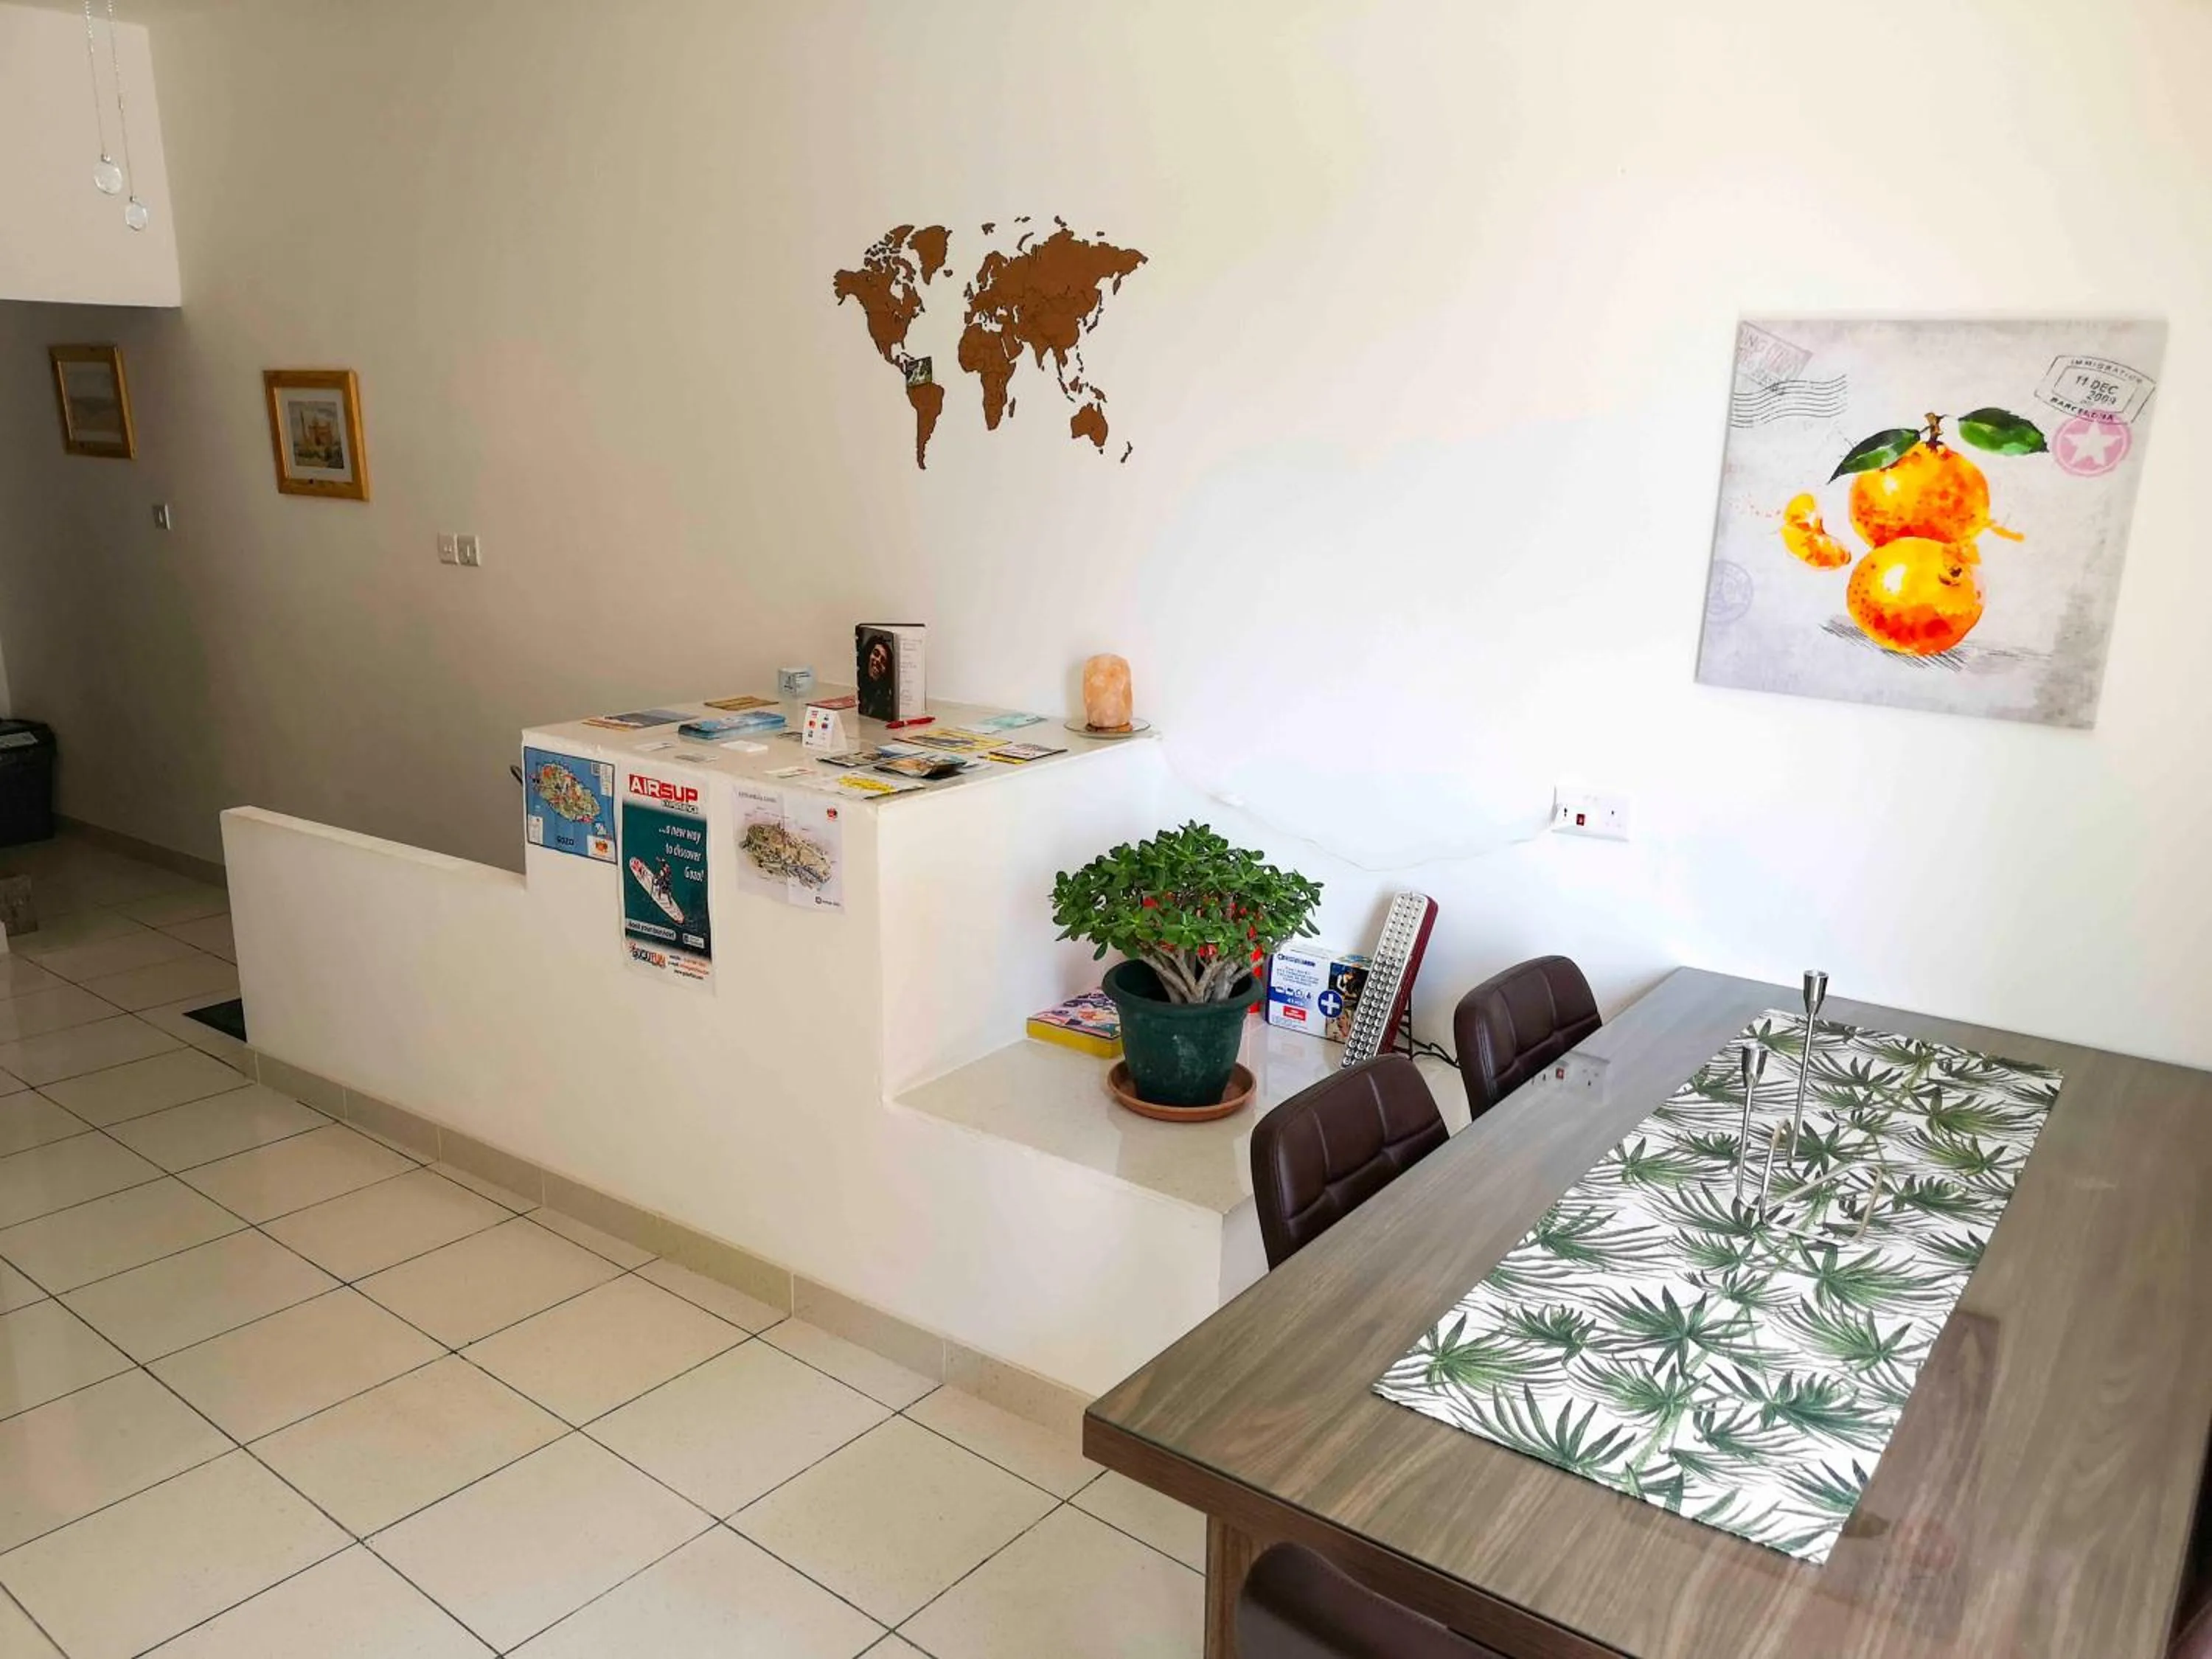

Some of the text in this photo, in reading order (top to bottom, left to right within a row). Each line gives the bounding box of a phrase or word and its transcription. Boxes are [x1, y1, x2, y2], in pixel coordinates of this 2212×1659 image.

[2071, 359, 2142, 383] IMMIGRATION
[2076, 375, 2119, 394] 11 DEC
[629, 774, 698, 802] AIRSUP
[686, 830, 701, 845] way
[674, 844, 701, 862] discover
